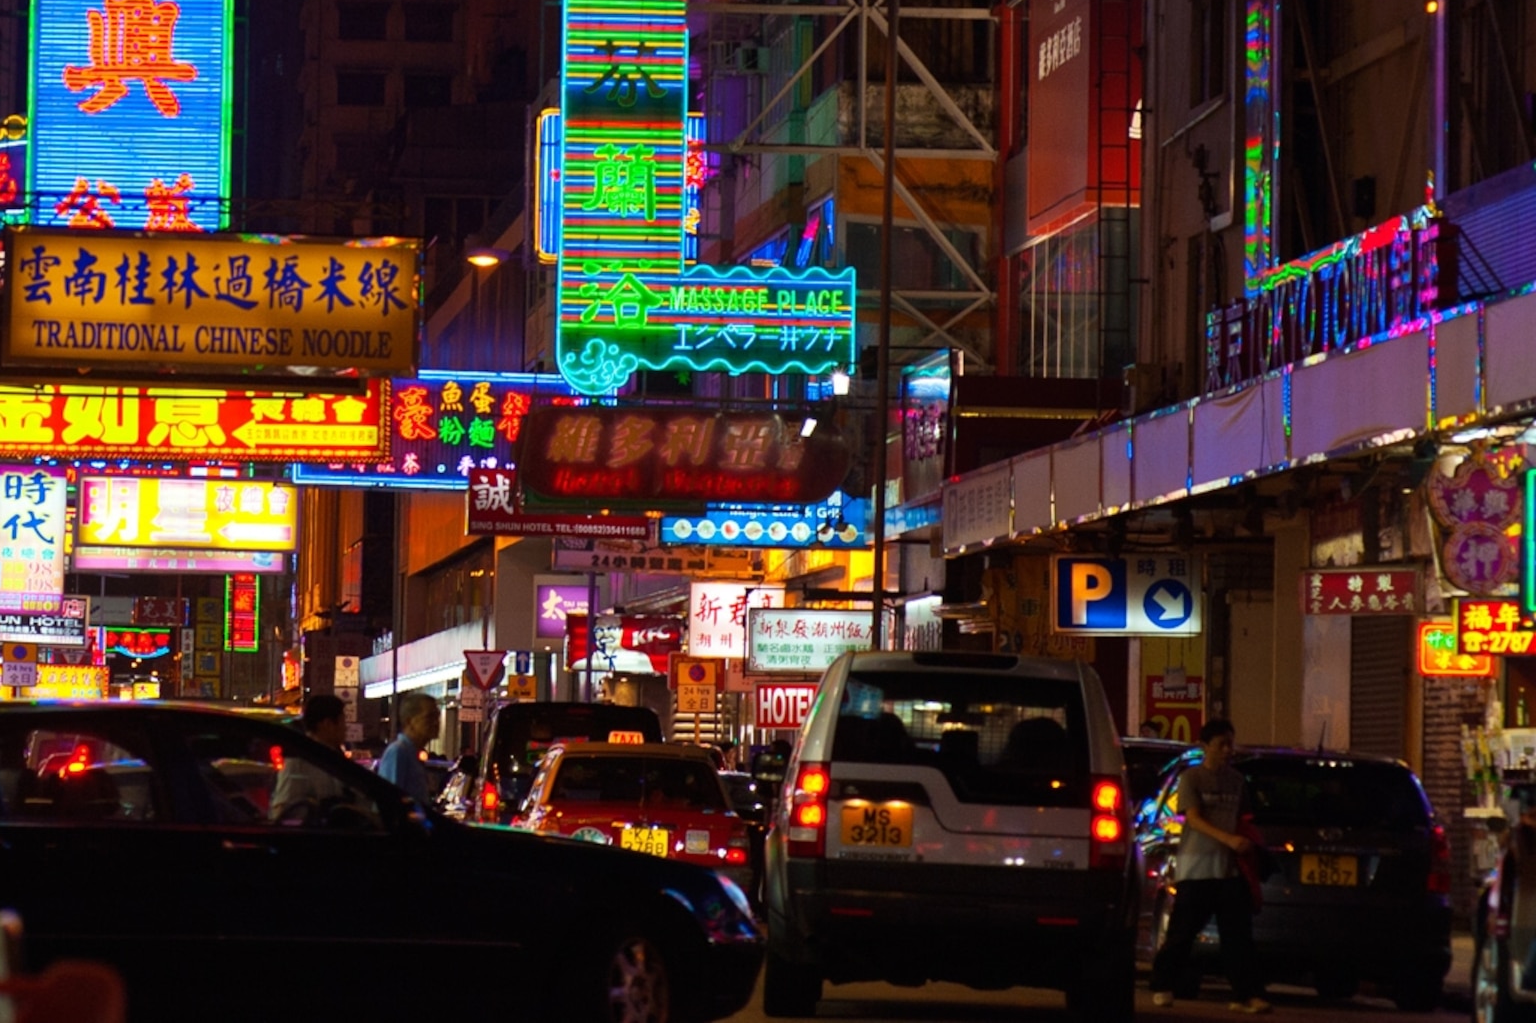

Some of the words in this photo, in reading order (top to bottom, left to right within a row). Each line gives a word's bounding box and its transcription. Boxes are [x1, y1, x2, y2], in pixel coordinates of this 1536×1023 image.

[20, 245, 409, 316] 雲南桂林過橋米線
[670, 287, 768, 314] MASSAGE
[777, 290, 843, 315] PLACE
[33, 320, 186, 353] TRADITIONAL
[195, 326, 293, 356] CHINESE
[302, 329, 392, 360] NOODLE
[440, 380, 495, 414] 魚蛋
[438, 416, 496, 448] 粉麵
[496, 521, 521, 533] SHUN
[523, 522, 553, 534] HOTEL
[1071, 562, 1113, 626] P
[29, 616, 84, 629] HOTEL
[631, 624, 671, 647] KFC
[684, 687, 695, 696] 24
[697, 686, 710, 696] hrs
[687, 698, 709, 710] 全日
[613, 733, 642, 744] TAXI
[864, 809, 890, 825] MS
[851, 826, 902, 845] 3213
